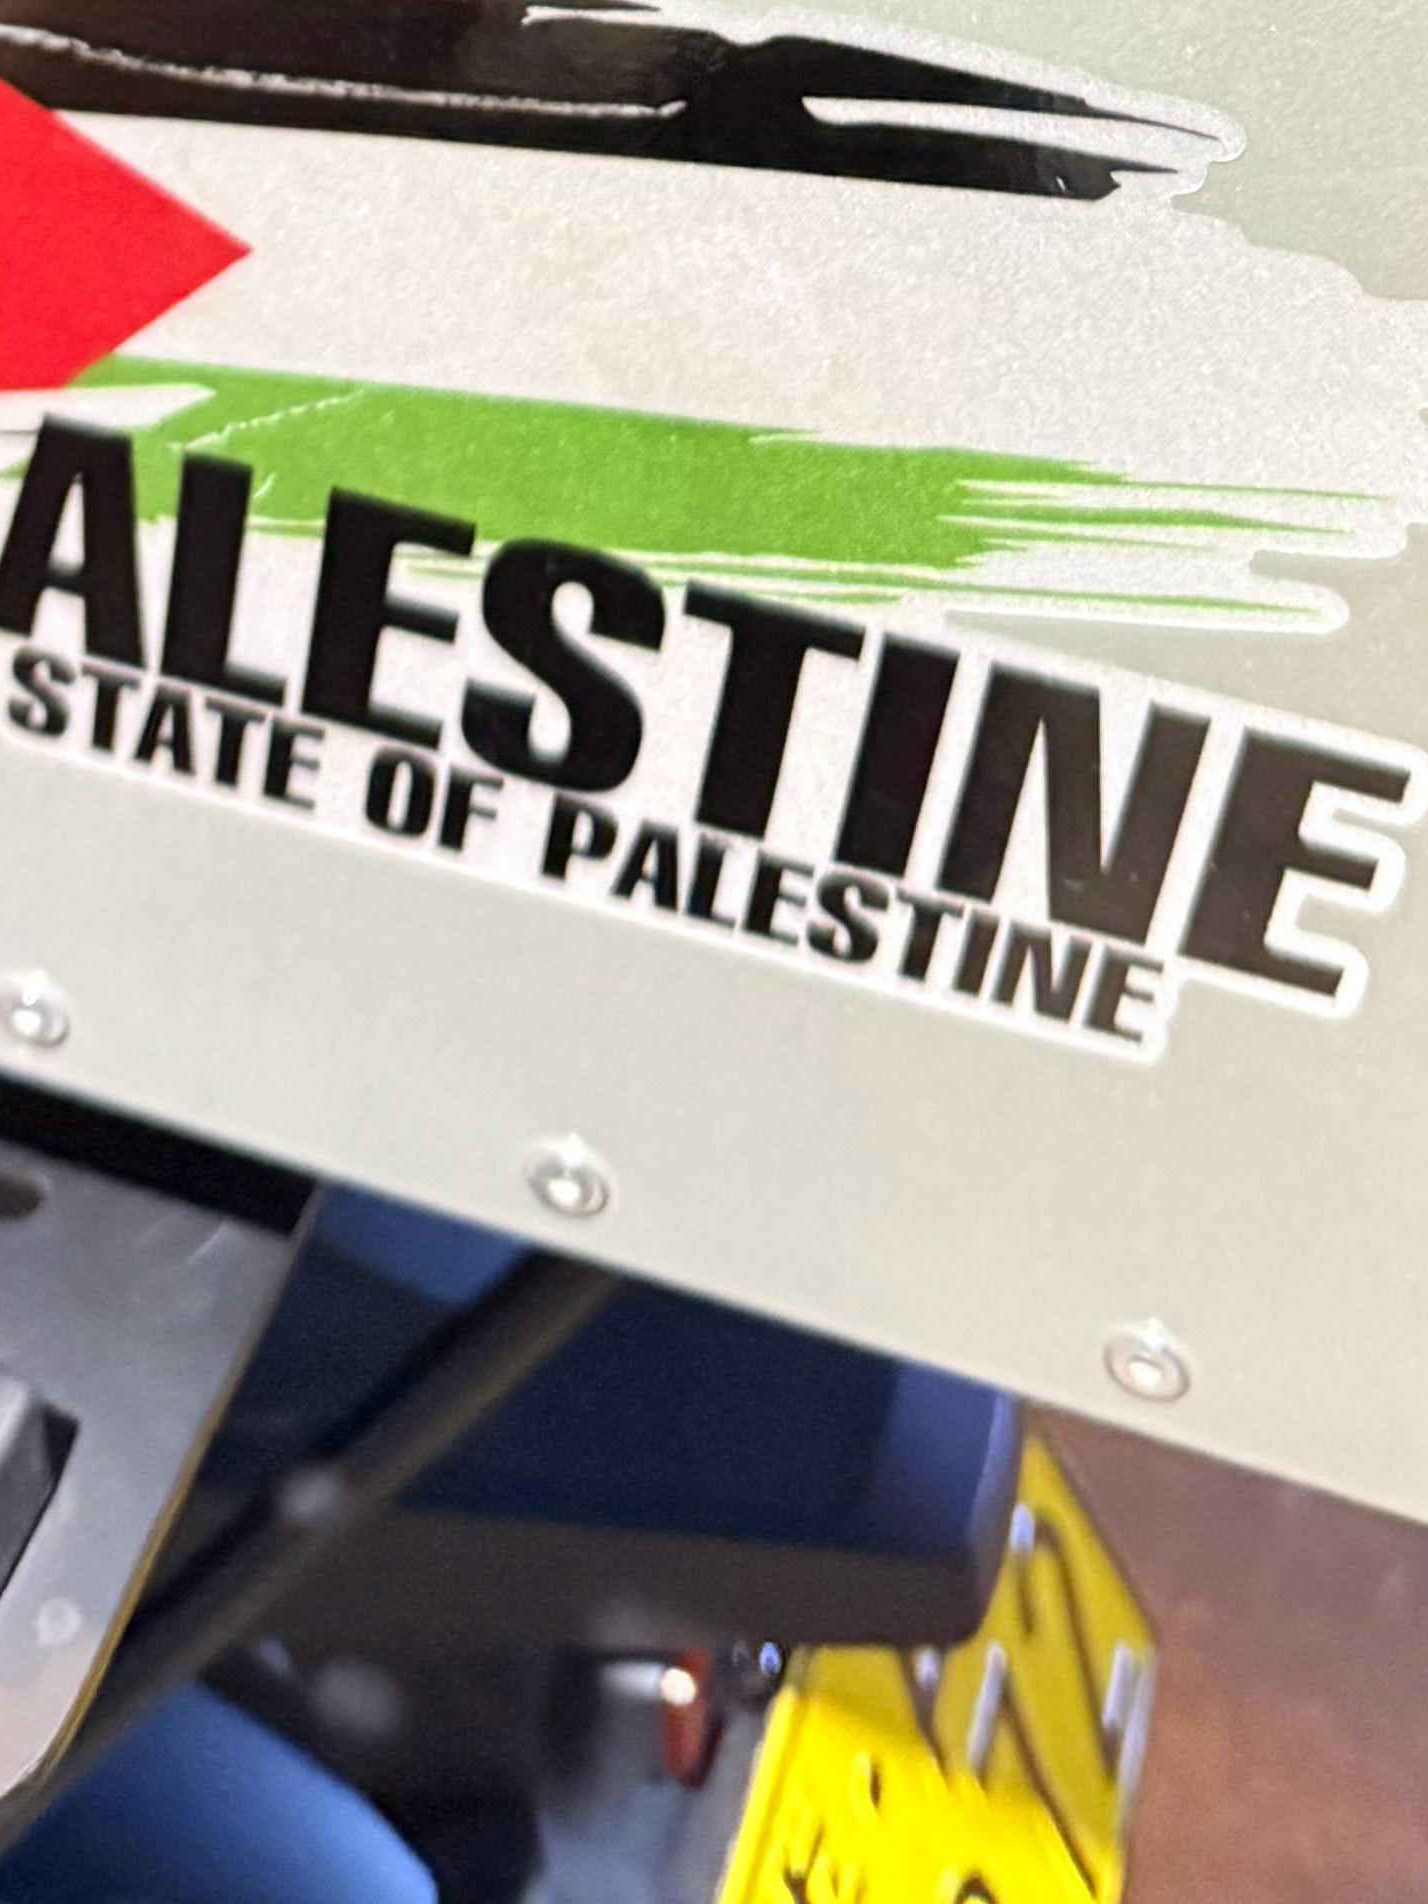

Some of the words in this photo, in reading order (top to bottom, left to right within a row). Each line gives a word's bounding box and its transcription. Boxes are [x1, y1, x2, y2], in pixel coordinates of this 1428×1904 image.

[5, 650, 326, 814] STATE
[365, 744, 502, 854] OF
[542, 792, 1166, 1046] PALESTINE
